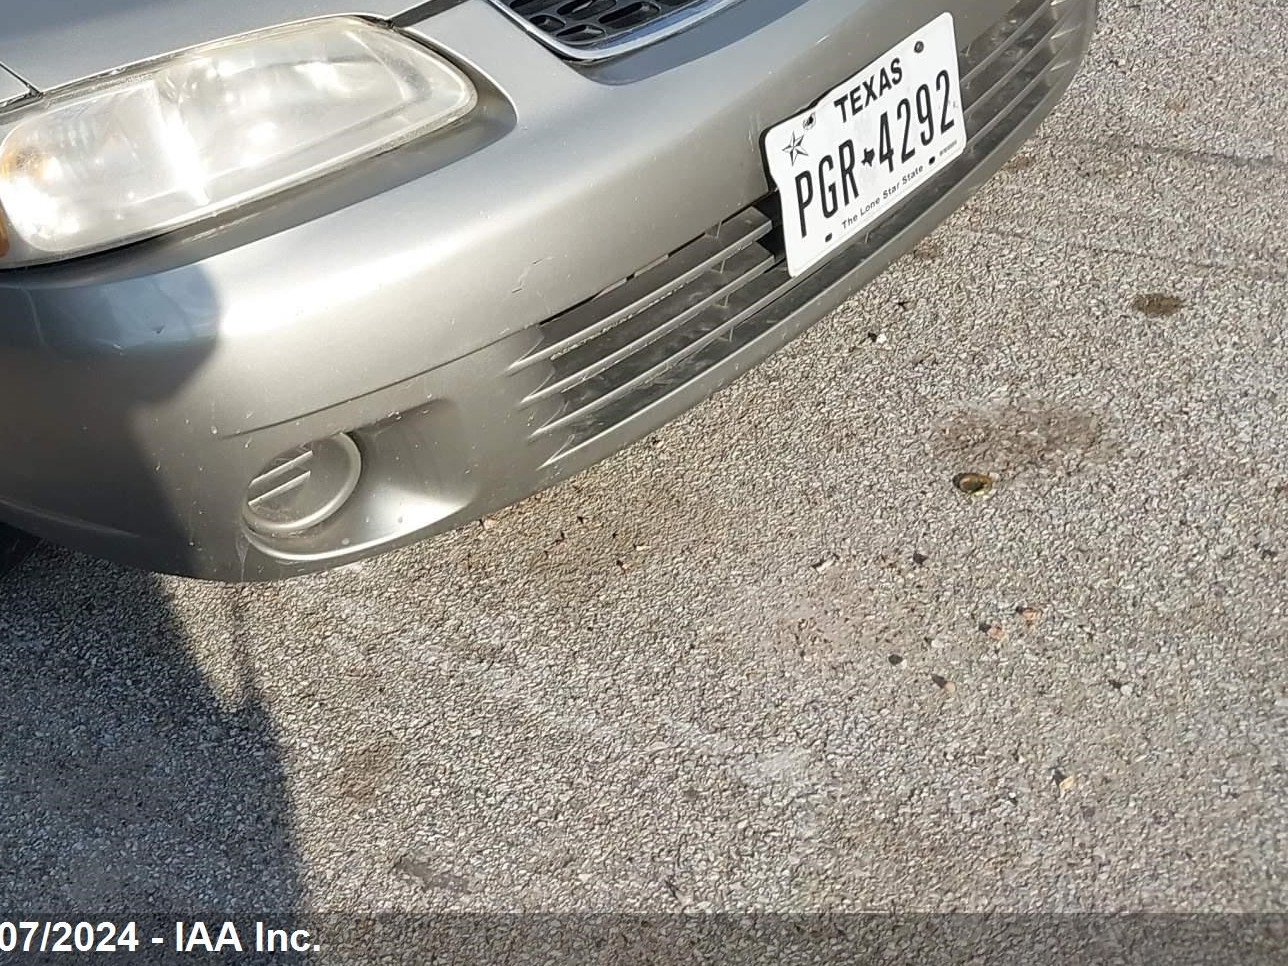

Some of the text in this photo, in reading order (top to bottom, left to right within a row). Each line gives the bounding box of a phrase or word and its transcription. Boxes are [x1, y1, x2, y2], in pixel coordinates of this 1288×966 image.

[833, 57, 904, 124] TEXAS
[841, 165, 923, 231] The Lone Star State
